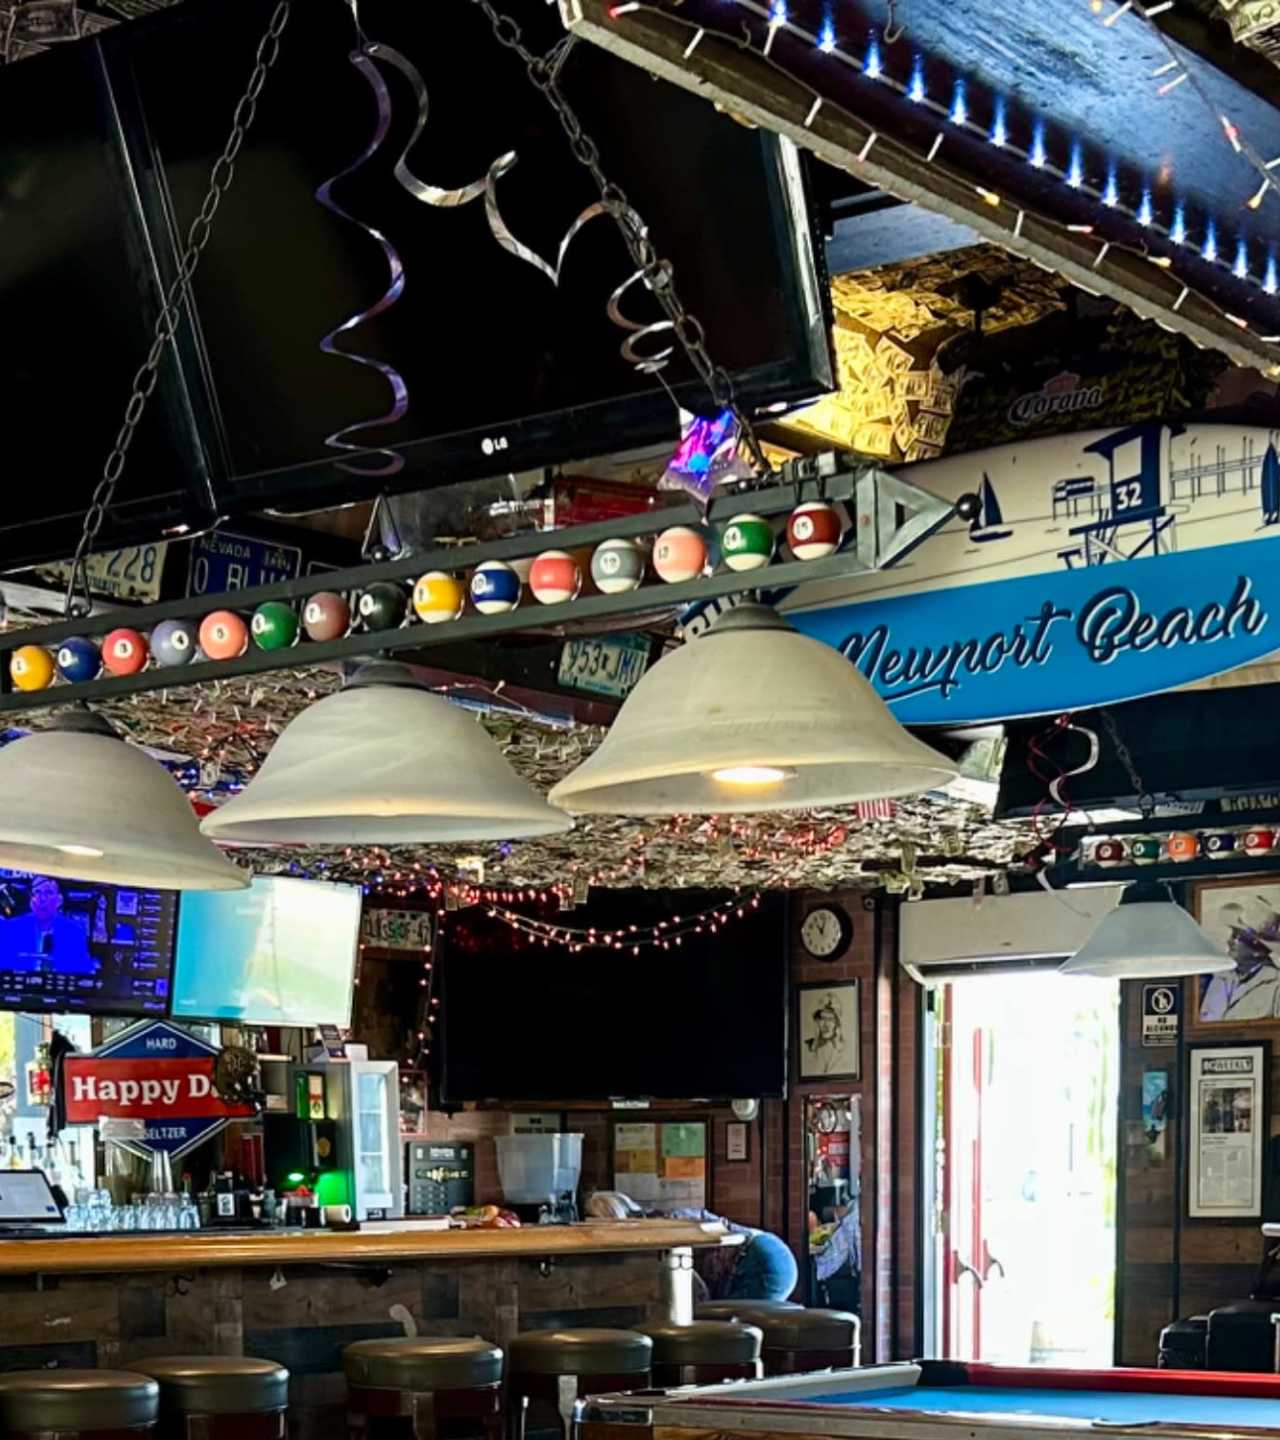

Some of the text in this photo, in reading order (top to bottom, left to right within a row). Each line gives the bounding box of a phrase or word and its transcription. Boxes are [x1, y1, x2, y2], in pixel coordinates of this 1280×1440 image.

[1008, 386, 1104, 425] Corona
[1115, 482, 1143, 510] 32
[200, 536, 251, 560] NEVADA
[836, 601, 1072, 701] Newport
[1077, 575, 1268, 665] Beach
[146, 1038, 176, 1050] HARD
[72, 1076, 181, 1106] Happy
